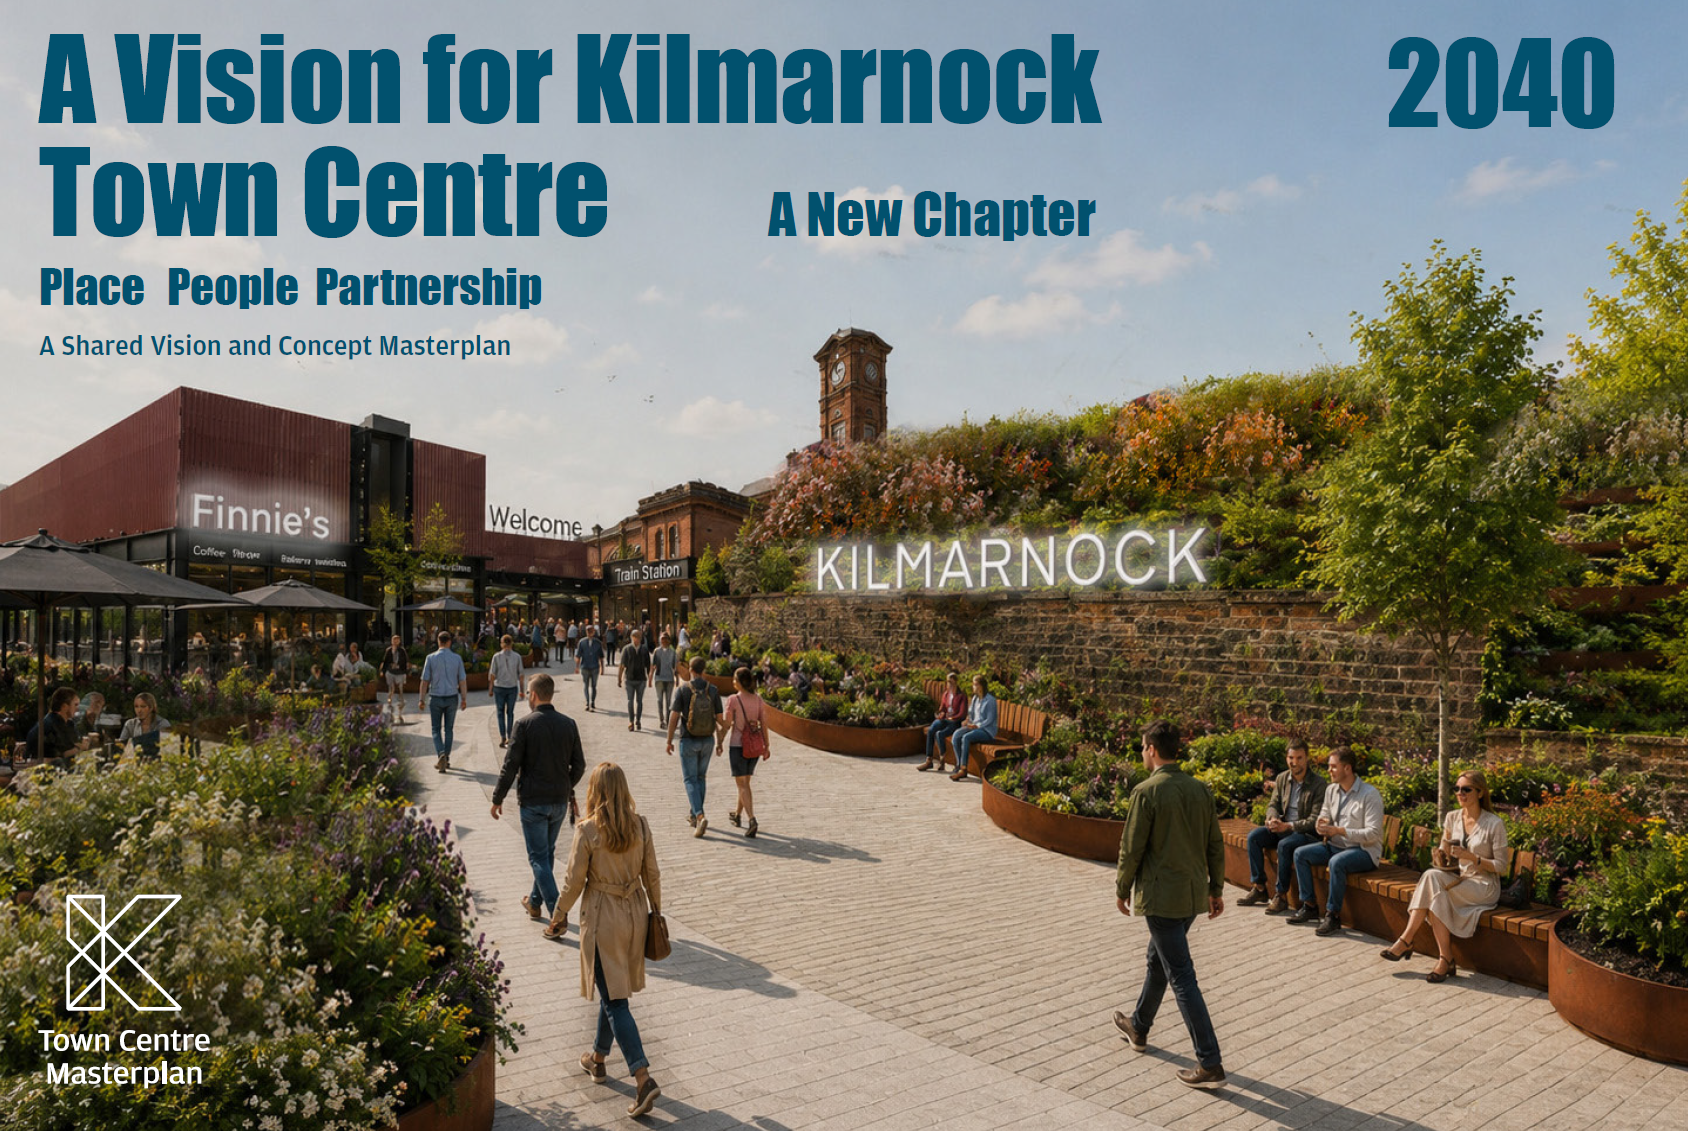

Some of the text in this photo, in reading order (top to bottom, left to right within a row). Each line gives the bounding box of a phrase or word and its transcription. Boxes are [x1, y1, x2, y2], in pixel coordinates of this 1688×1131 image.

[192, 492, 331, 540] Finnie's
[488, 503, 584, 538] Welcome
[614, 562, 681, 584] Train Station
[816, 527, 1208, 592] KILMARNOCK
